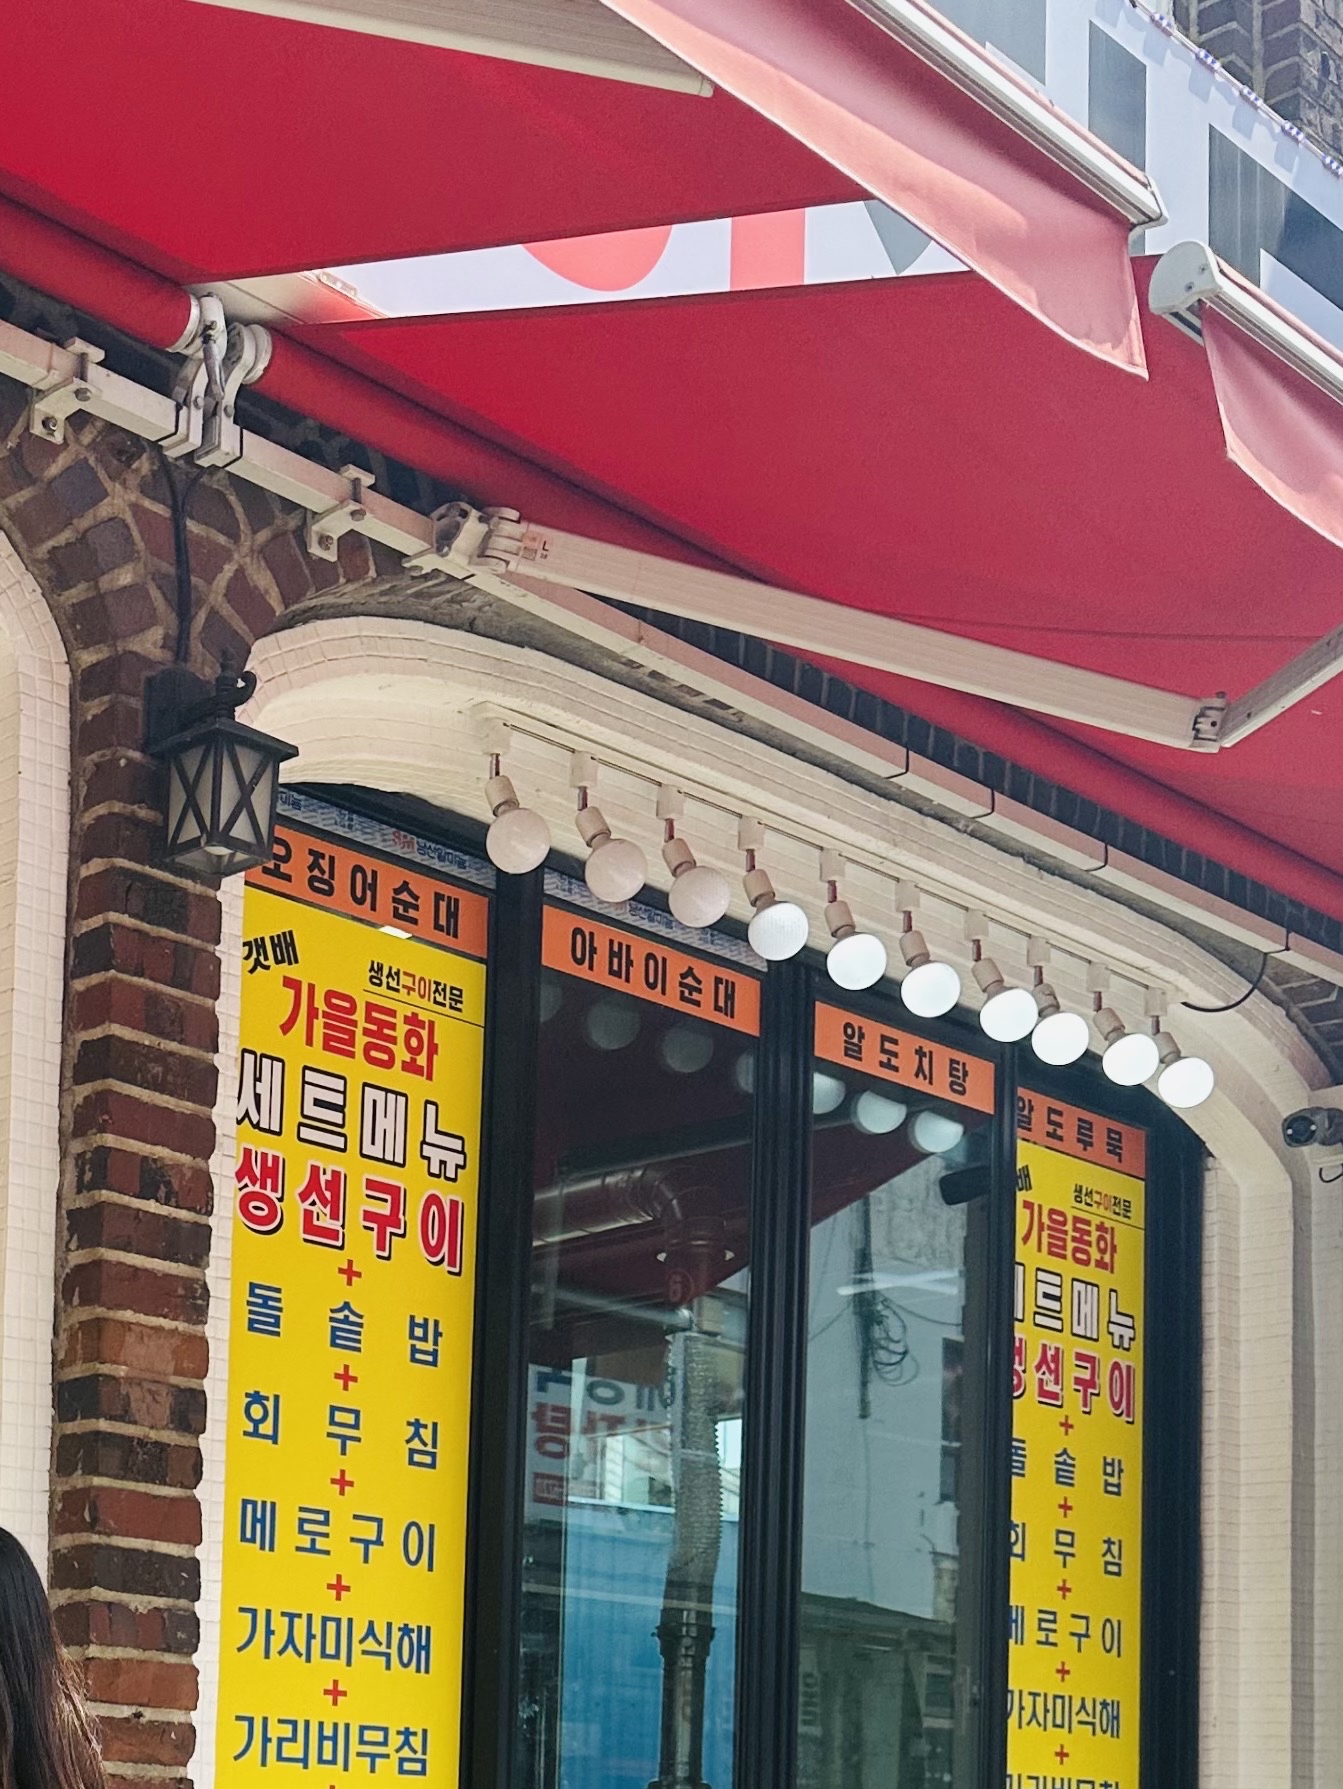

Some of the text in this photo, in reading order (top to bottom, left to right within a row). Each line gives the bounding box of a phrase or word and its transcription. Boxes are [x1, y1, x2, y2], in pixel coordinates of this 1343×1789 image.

[241, 930, 300, 975] 갯배
[368, 959, 465, 1013] 생선구이전문
[570, 926, 737, 1019] 아바이순대
[279, 975, 439, 1083] 가을동화
[237, 1048, 467, 1183] 세트메뉴
[235, 1144, 465, 1277] 생선구이
[1022, 1200, 1117, 1274] 가을동화
[1073, 1183, 1132, 1220] 생선구이전문
[236, 1606, 432, 1675] 가자미식해
[232, 1715, 429, 1777] 가리비무침
